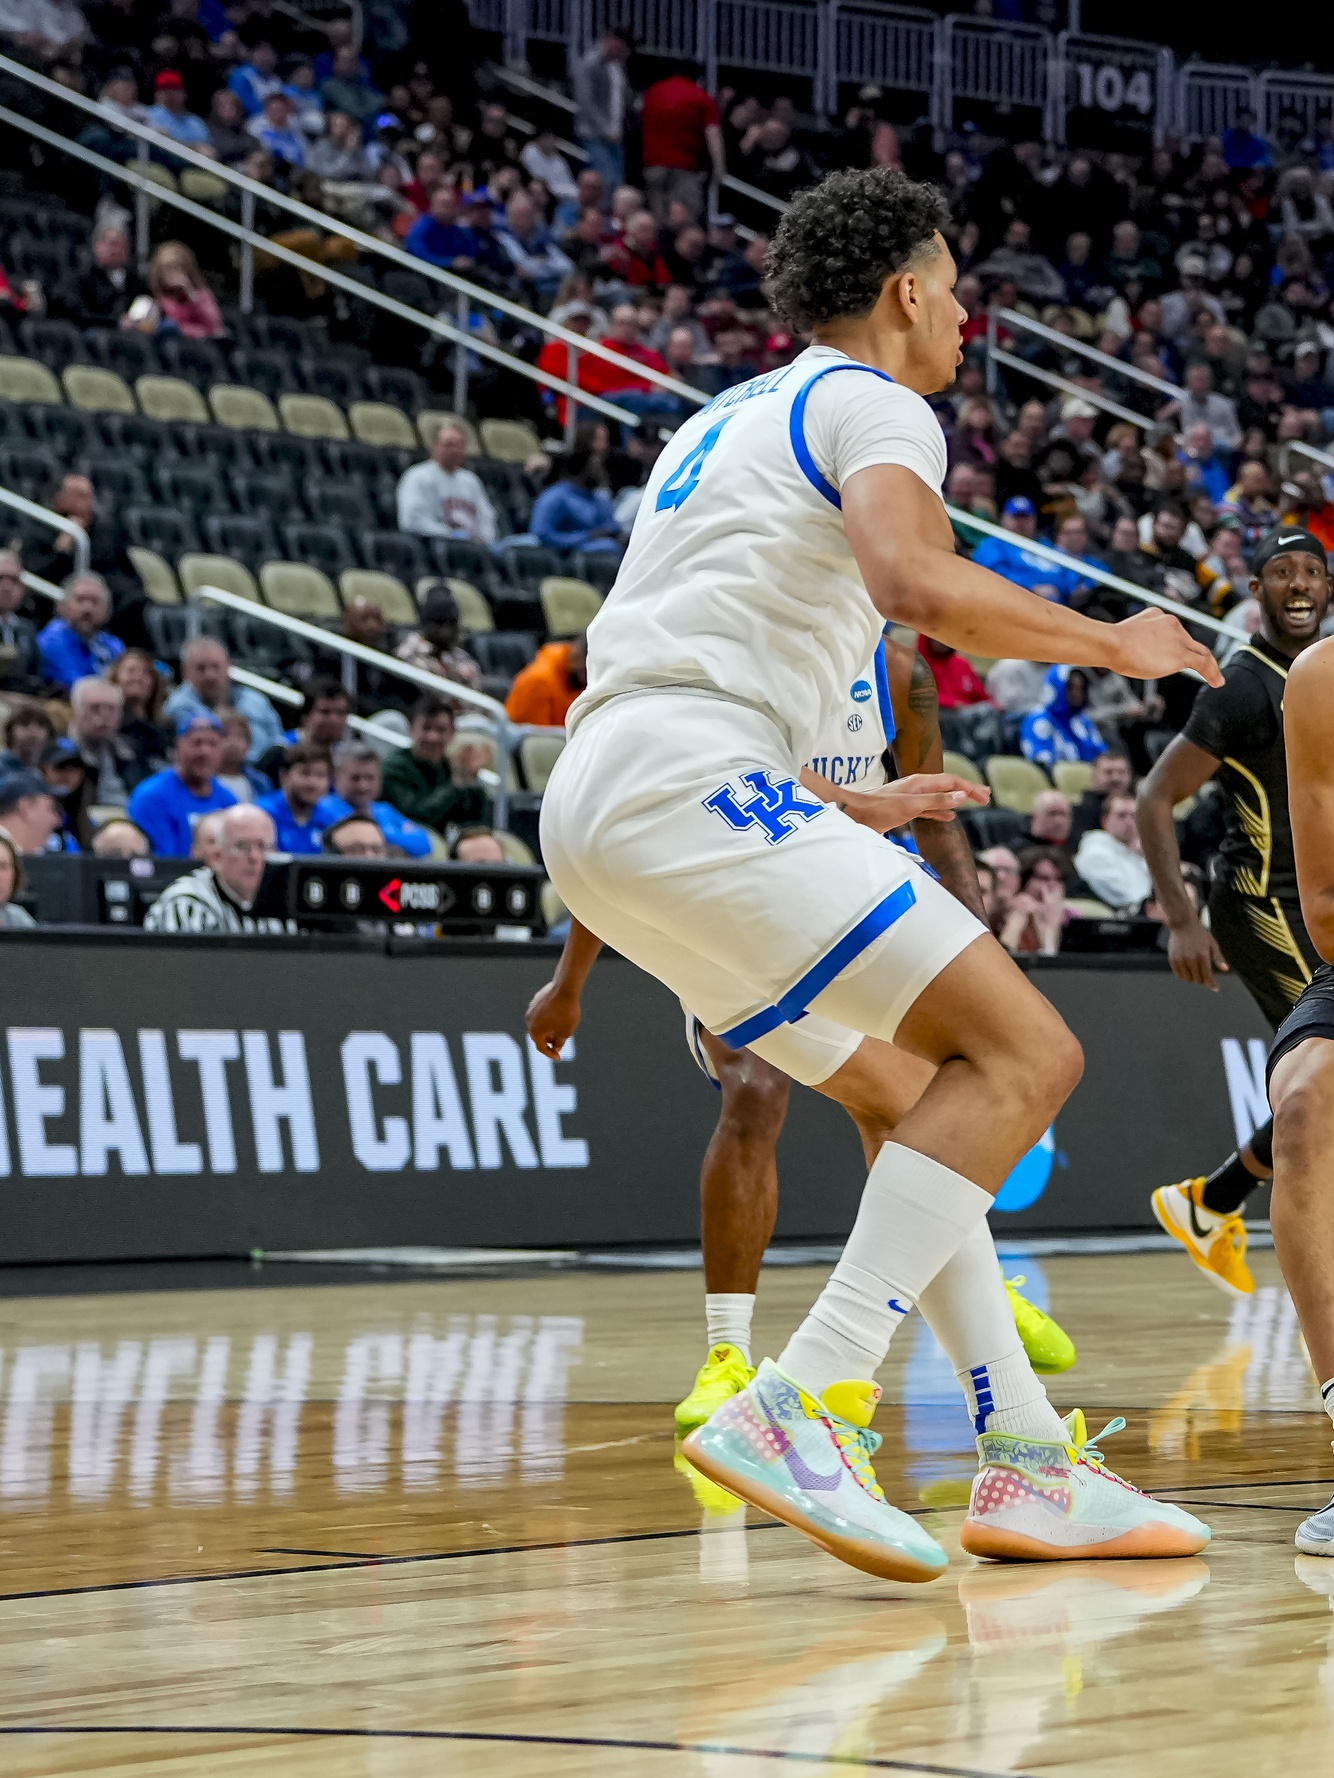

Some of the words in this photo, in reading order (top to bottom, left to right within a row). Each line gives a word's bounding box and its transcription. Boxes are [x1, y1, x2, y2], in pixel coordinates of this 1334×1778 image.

[1078, 63, 1151, 114] 104
[655, 414, 735, 513] 4
[848, 714, 863, 732] SEC
[803, 755, 876, 787] UCKY
[702, 770, 829, 846] UK
[0, 1026, 320, 1178] EALTH
[340, 1030, 590, 1173] CARE
